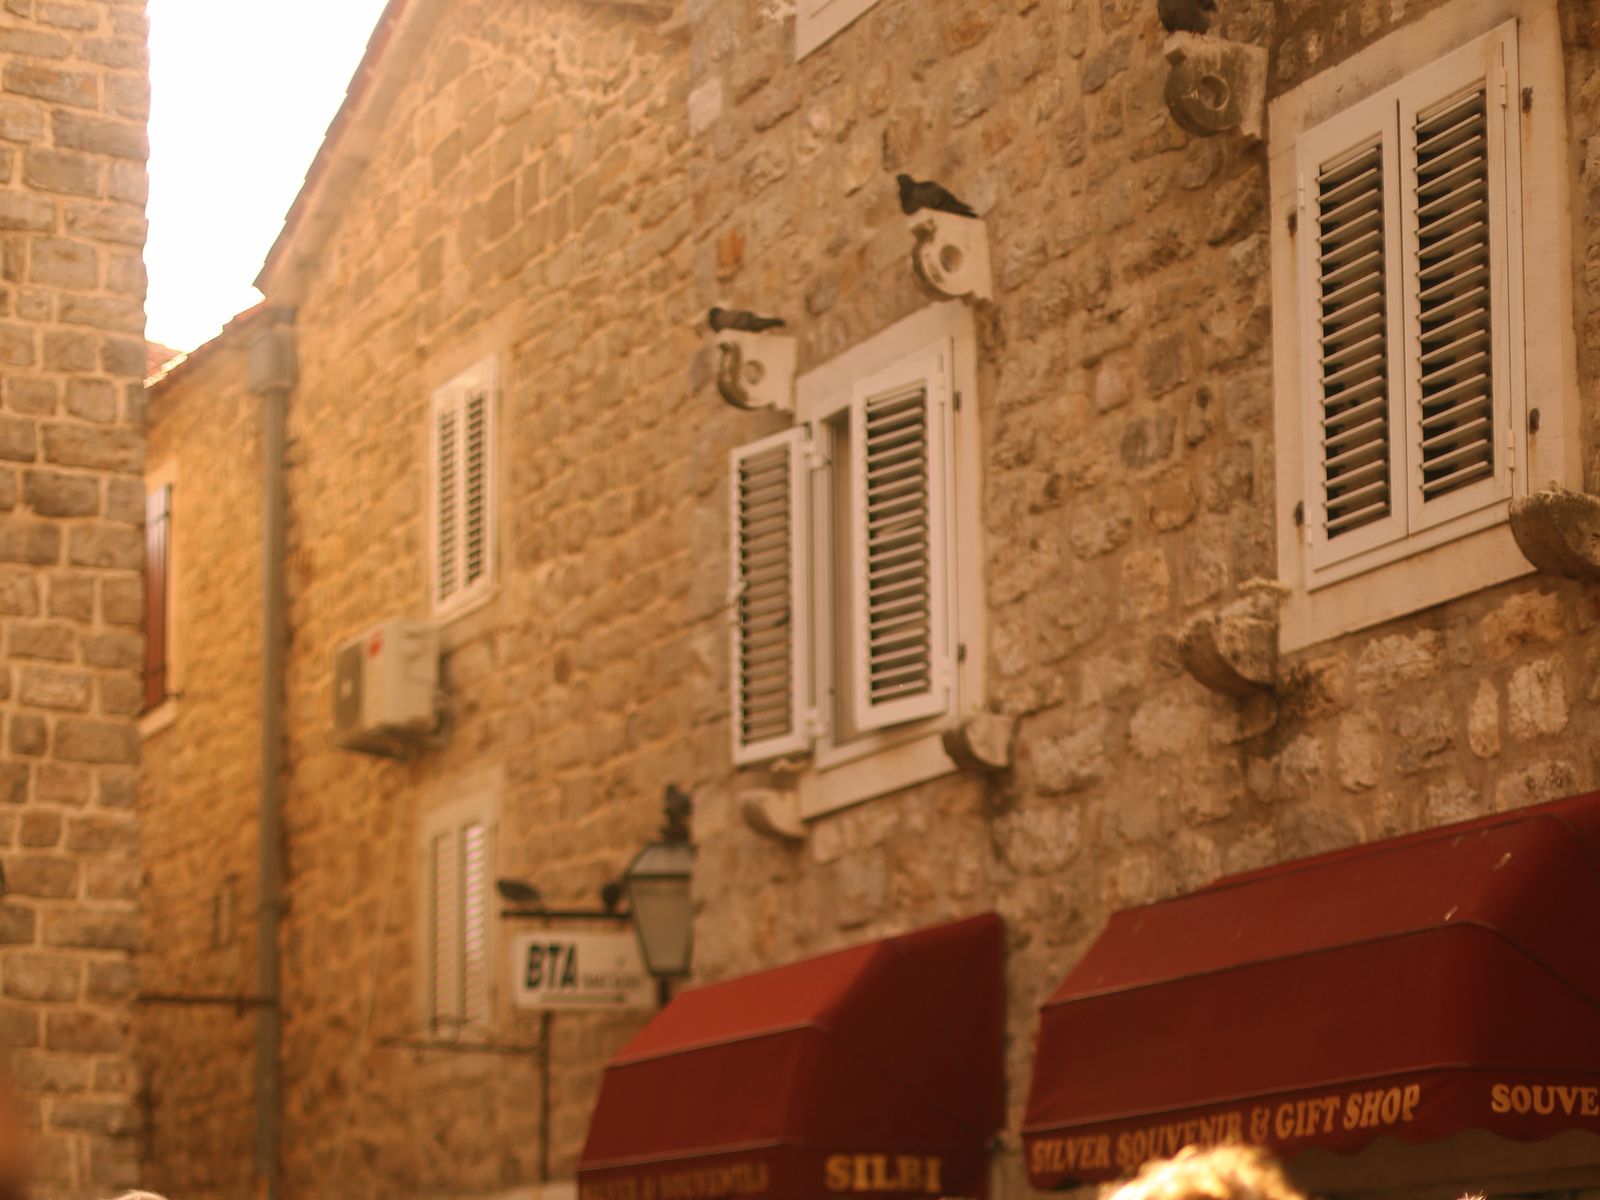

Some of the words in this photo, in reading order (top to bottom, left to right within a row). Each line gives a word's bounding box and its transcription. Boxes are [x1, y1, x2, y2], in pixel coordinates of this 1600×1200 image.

[526, 943, 577, 988] BTA
[1491, 1084, 1599, 1115] SOUVE
[1031, 1135, 1110, 1173] SILVER
[1252, 1106, 1271, 1141] &
[1276, 1098, 1340, 1139] GIFT
[1344, 1085, 1420, 1129] SHOP
